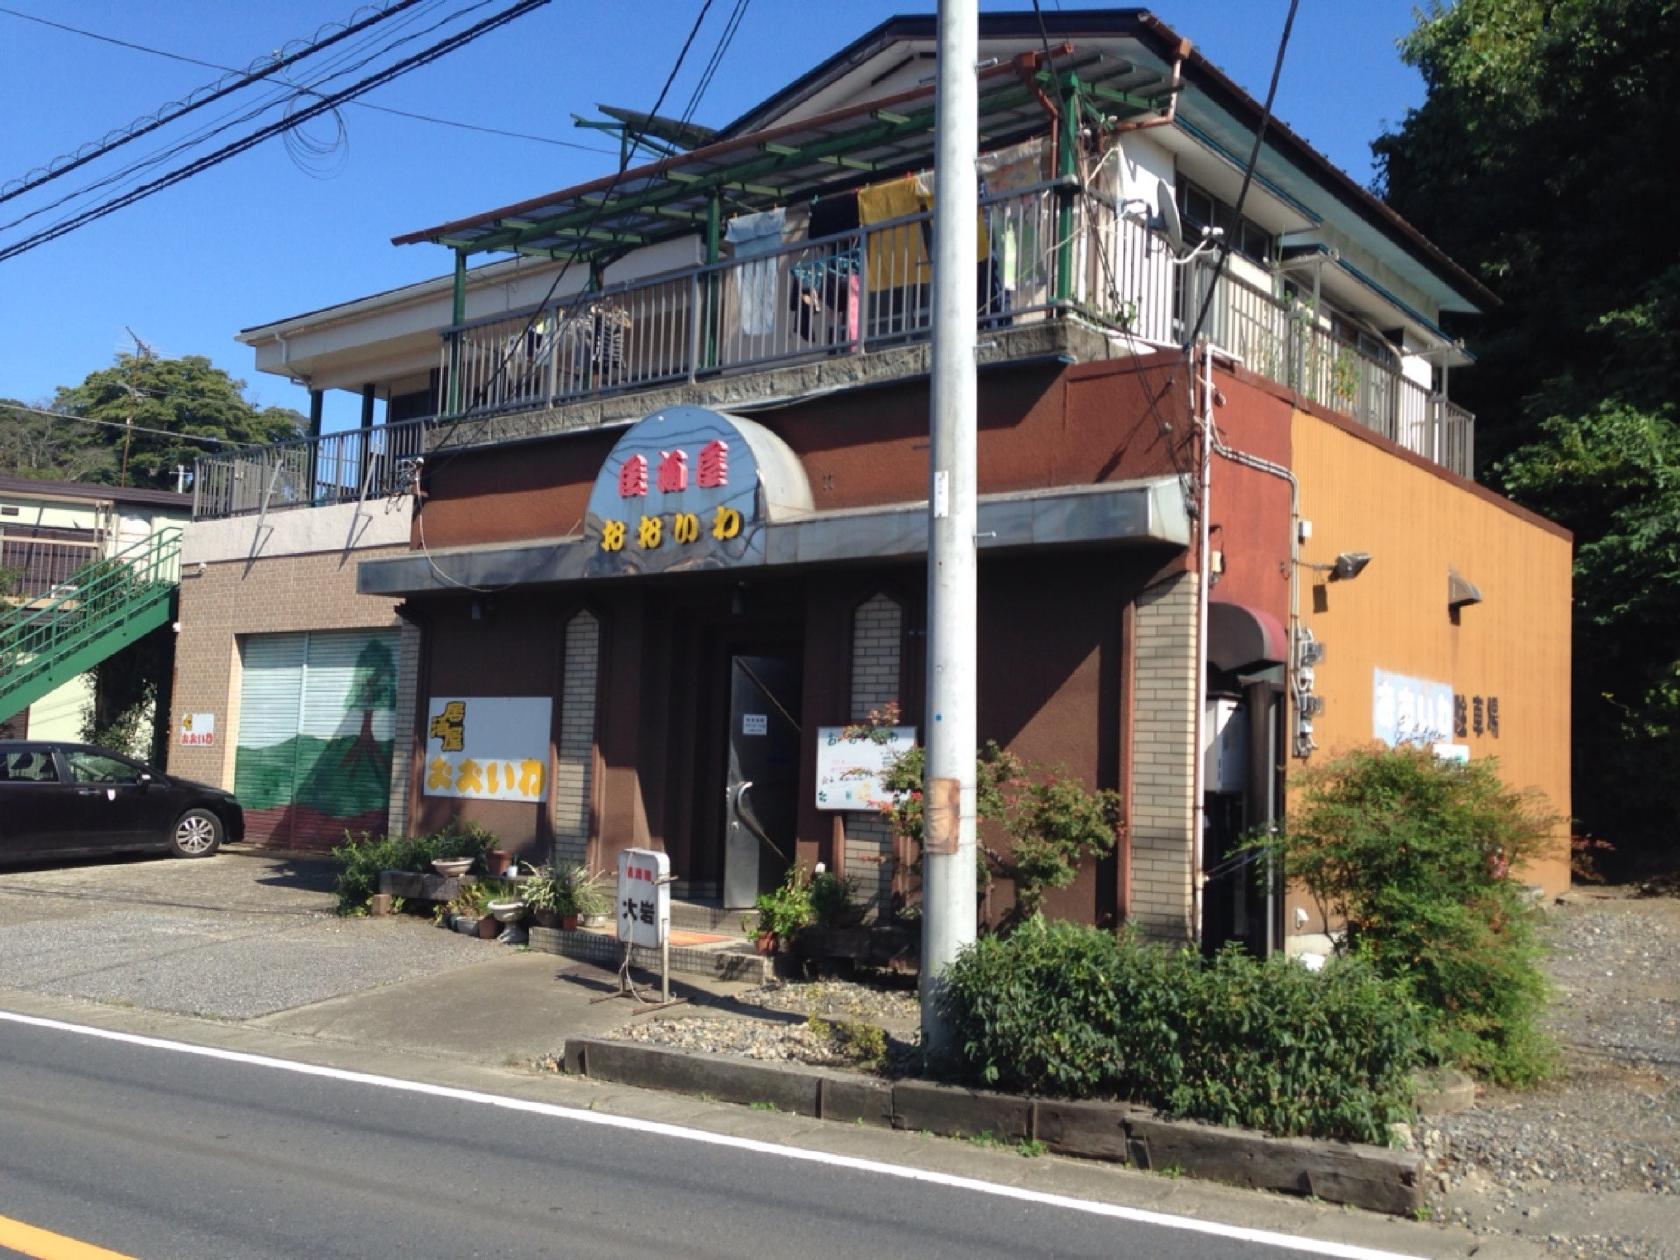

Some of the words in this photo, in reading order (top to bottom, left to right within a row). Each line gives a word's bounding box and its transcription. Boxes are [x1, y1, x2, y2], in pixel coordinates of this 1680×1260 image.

[601, 505, 743, 552] おおいわ
[427, 757, 545, 797] おおいわ
[622, 898, 655, 926] 大岩
